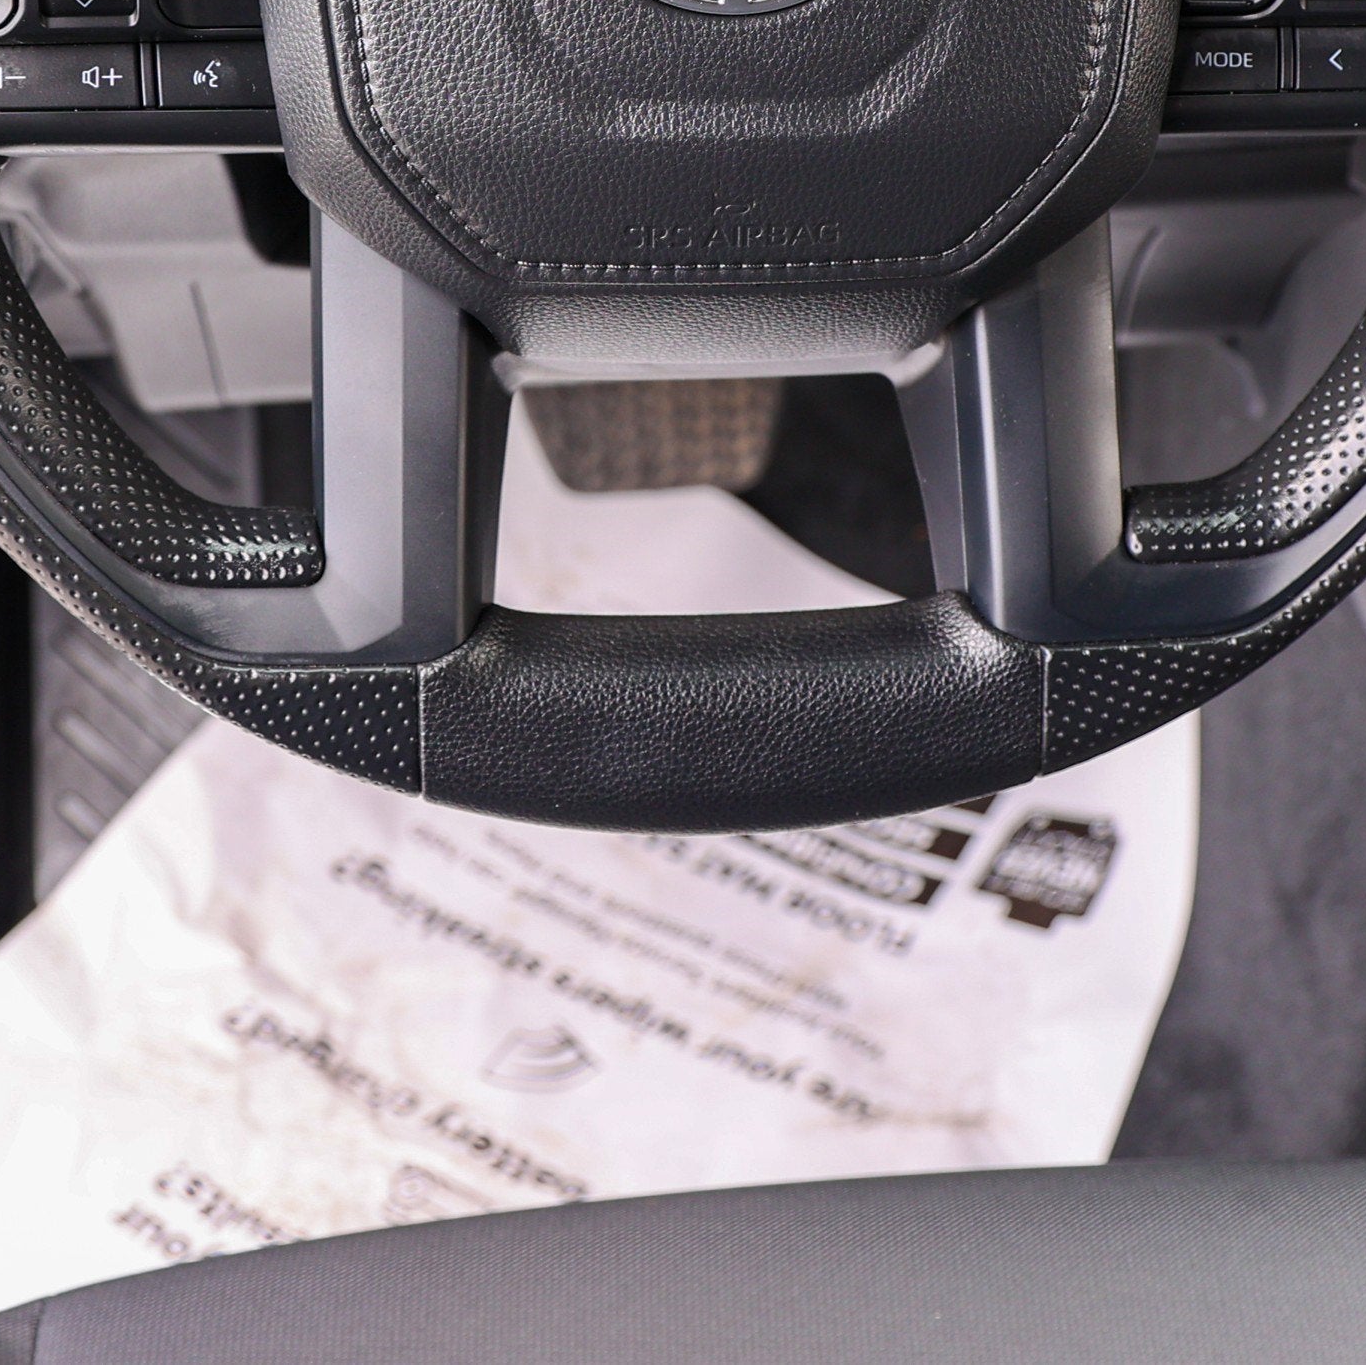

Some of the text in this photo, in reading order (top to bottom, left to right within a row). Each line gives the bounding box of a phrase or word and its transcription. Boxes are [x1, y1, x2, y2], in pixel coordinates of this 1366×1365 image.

[1194, 51, 1254, 69] MODE
[628, 222, 841, 250] SRS AIRBAG
[328, 853, 542, 979] streaking?
[550, 971, 690, 1054] wipers
[695, 1037, 802, 1090] your
